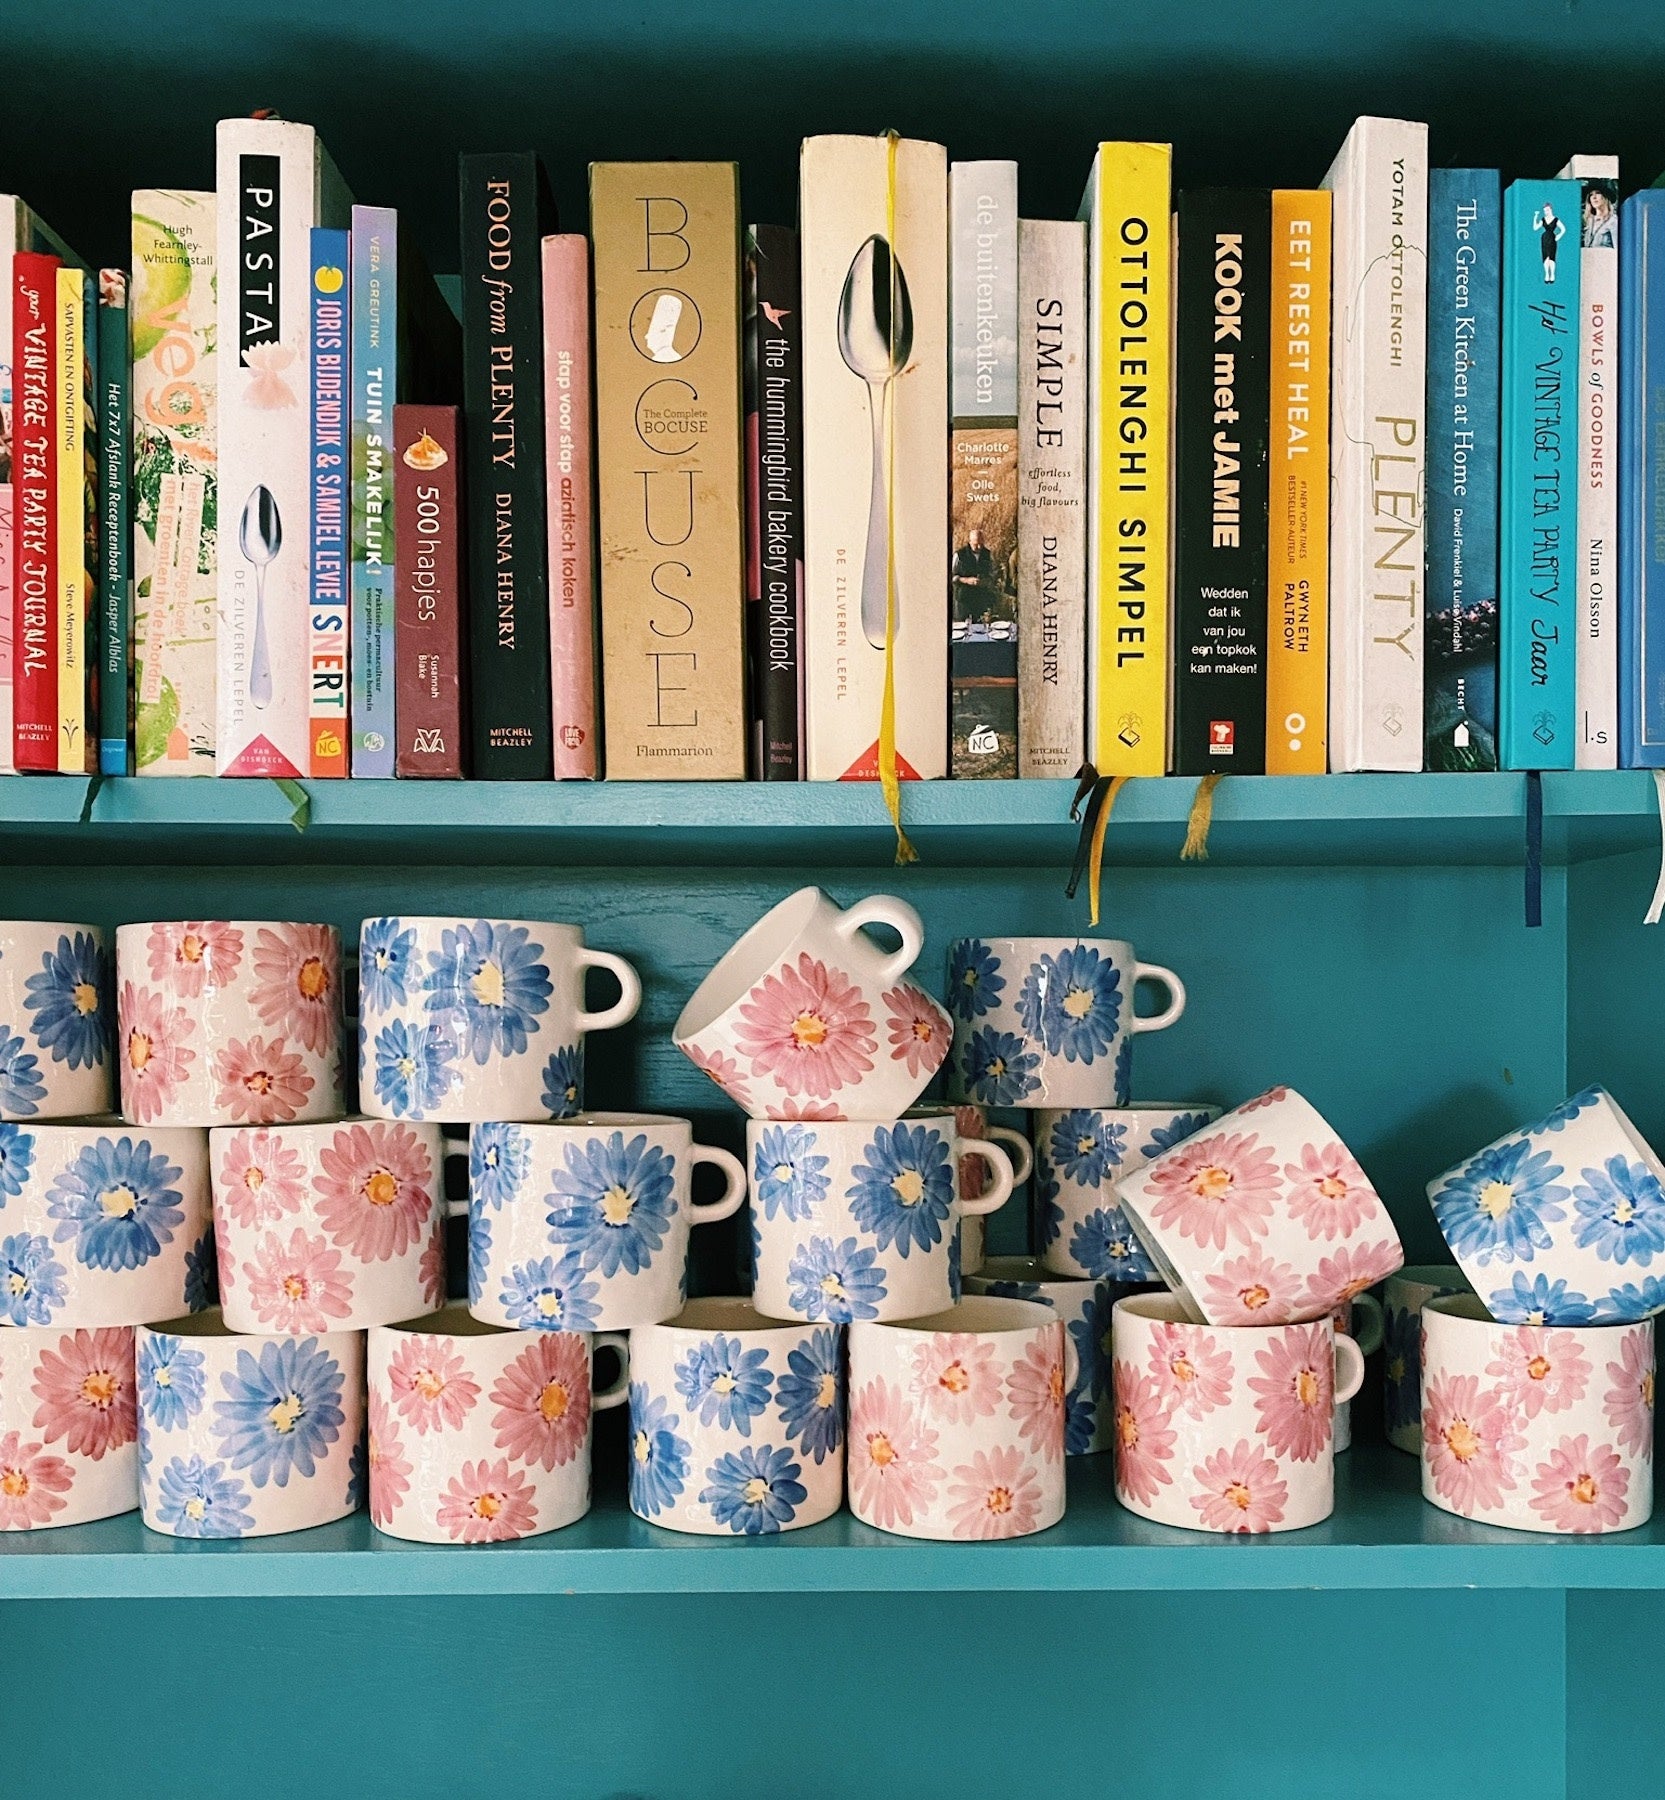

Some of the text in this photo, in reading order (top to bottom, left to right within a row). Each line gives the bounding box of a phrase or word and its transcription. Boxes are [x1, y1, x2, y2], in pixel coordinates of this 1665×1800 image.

[154, 239, 202, 252] Fearnley-
[163, 224, 192, 237] Hugh
[143, 254, 213, 267] Whittingstall
[245, 187, 273, 335] PASTA
[1390, 158, 1405, 367] YOTAM OTTOLENGHI
[369, 236, 380, 349] VERA GREUTINK
[976, 194, 999, 404] de buitenkeuken
[482, 180, 515, 470] FOOD from PLENTY
[1287, 220, 1311, 460] EET RESET HEAL
[1453, 199, 1477, 496] The Green Kitchen at Home
[64, 303, 75, 452] SAPVASTEN EN ONTGIFTING
[1036, 298, 1063, 448] SIMPLE
[1213, 233, 1243, 548] KOOK met JAMIE
[1589, 304, 1603, 489] BOWLS of GOODNESS
[643, 408, 708, 421] The Complete
[644, 422, 708, 433] BOCUSE
[1534, 347, 1563, 461] VINTAGE
[315, 298, 341, 599] JORIS BIJDENDIJK & SAMUEL LEVIE
[365, 367, 382, 576] TUIN SMAKELIJK!
[957, 442, 1009, 453] Charlotte
[964, 455, 1002, 465] Marres
[1118, 217, 1148, 668] OTTOLENGHI SIMPEL
[20, 276, 48, 676] your VINTAGE TEA PARTY JOURNAL
[186, 481, 200, 504] het
[556, 350, 575, 608] stap voor stap aziatisch koken
[966, 492, 999, 503] Swets
[971, 479, 994, 490] Olle
[1021, 497, 1079, 508] big flavours
[1028, 468, 1071, 479] effortless
[1037, 482, 1061, 494] food,
[1534, 469, 1560, 518] TEA
[104, 383, 121, 673] Het 7x7 Afslank Receptenboek Jasper Alblas
[184, 508, 199, 543] River
[762, 339, 794, 671] the hummingbird bakery cookbook
[1287, 475, 1295, 564] BESTSELLER-AUTEUR
[1453, 508, 1463, 536] David
[412, 485, 441, 621] 500 hapjes
[1374, 416, 1416, 661] PLENTY
[1453, 539, 1463, 577] Frenkiel
[1530, 525, 1560, 606] PARTY
[147, 479, 178, 700] met groenten in de hoofdrol
[174, 546, 196, 597] Cottage
[495, 493, 515, 650] DIANA HENRY
[1200, 587, 1249, 599] Wedden
[1453, 579, 1463, 587] &
[1590, 539, 1602, 638] Nina Olsson
[65, 584, 76, 669] Steve Meyerowitz
[374, 587, 383, 692] Praktische permacultuur
[836, 549, 847, 701] DE ZILVEREN LEPEL
[1043, 536, 1058, 686] DIANA HENRY
[1203, 625, 1246, 638] van jou
[1208, 606, 1241, 617] dat ik
[1284, 583, 1295, 650] PALTROW
[1298, 580, 1309, 653] GWYNETH
[1453, 616, 1463, 653] Vindahl
[233, 570, 245, 725] DE ZILVEREN LEPEL
[312, 614, 343, 708] SNERT
[366, 668, 373, 678] en
[418, 654, 426, 680] Blake
[430, 654, 439, 699] Susannah
[1190, 663, 1257, 673] kan maken!
[1191, 644, 1257, 656] een topkok
[1531, 619, 1558, 686] Jaar
[366, 680, 374, 711] bostuin
[16, 723, 52, 731] MITCHELL
[319, 740, 338, 754] NC
[490, 728, 532, 737] MITCHELL
[490, 738, 532, 747] BEAZLEY
[636, 745, 713, 757] Flammarion
[972, 735, 994, 750] NC
